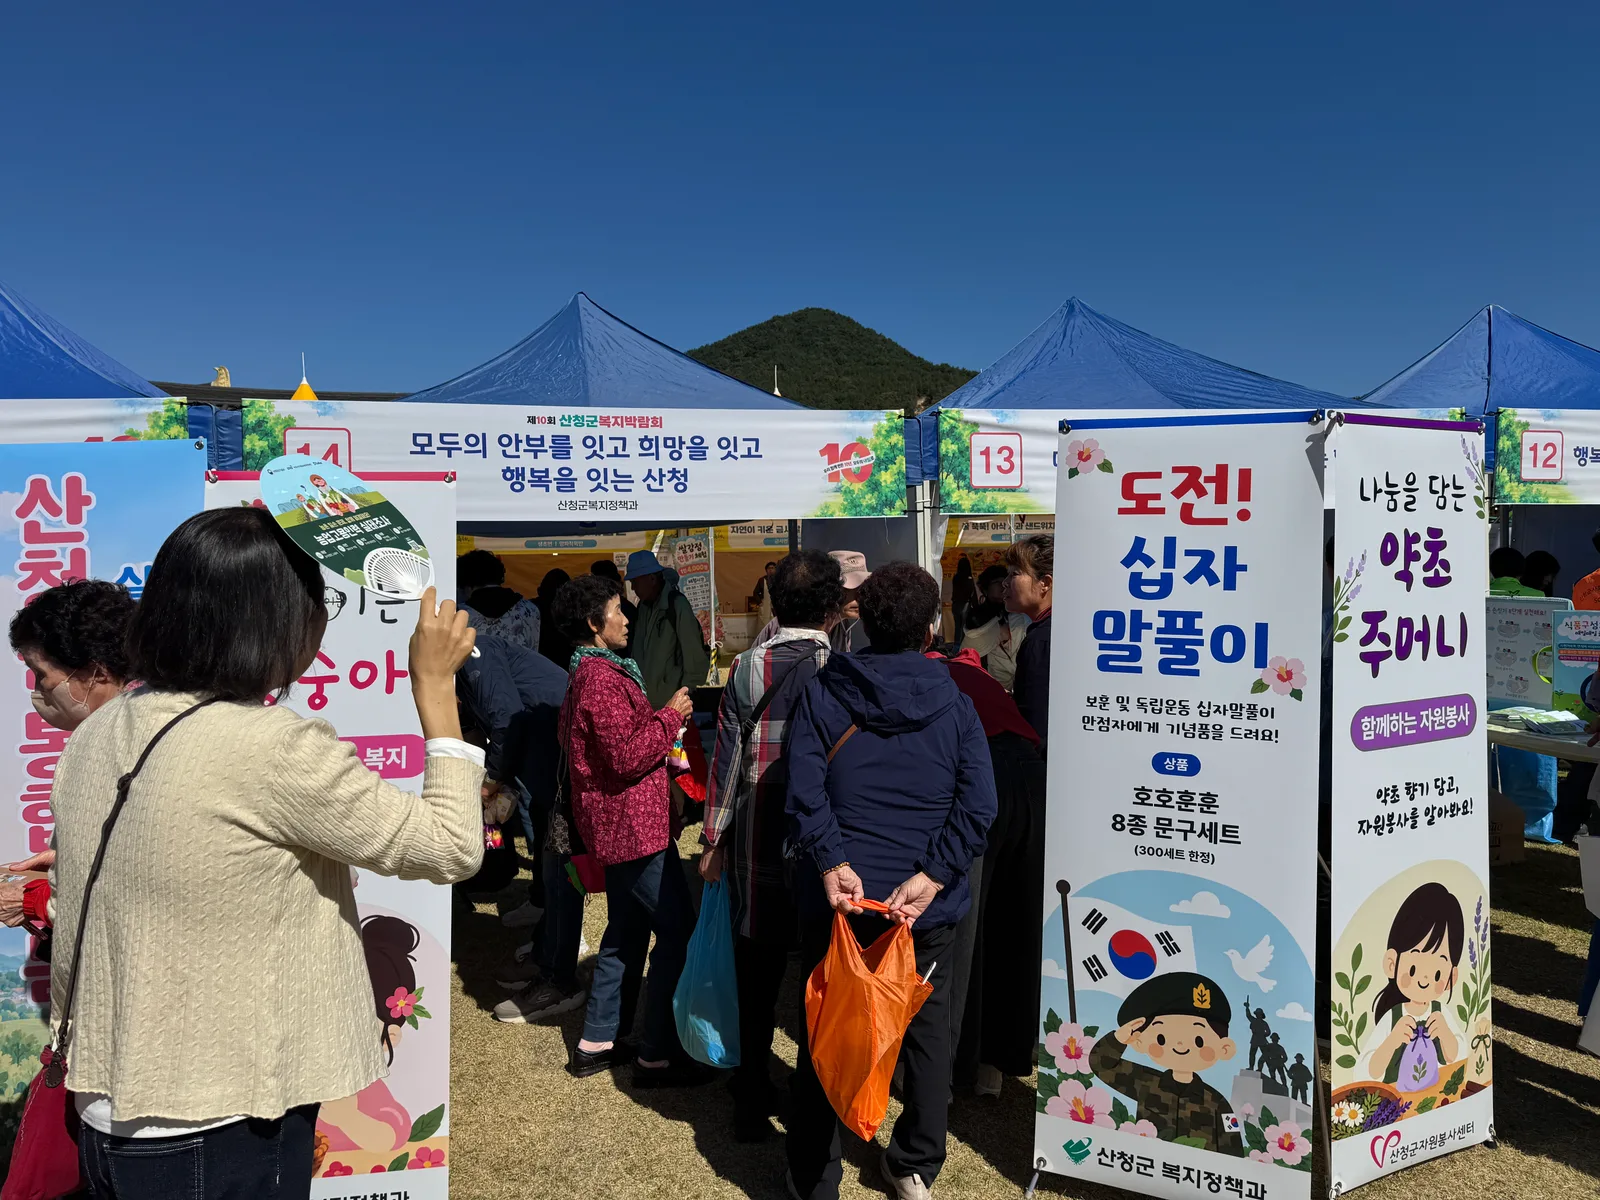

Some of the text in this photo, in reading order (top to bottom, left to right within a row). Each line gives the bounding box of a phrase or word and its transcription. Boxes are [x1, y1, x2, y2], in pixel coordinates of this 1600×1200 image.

[526, 414, 663, 428] 제10회 산청군복지박람회
[409, 432, 764, 461] 모두의 안부를 잇고 희망을 잇고
[979, 446, 1015, 475] 13
[1529, 442, 1557, 468] 12
[501, 466, 690, 494] 행복을 잇는 산청
[1360, 471, 1467, 513] 나눔을 담는
[557, 500, 639, 512] 산청군복지정책과
[1118, 464, 1252, 526] 도전!
[731, 525, 755, 533] 자연이
[1025, 522, 1055, 530] 샌드위치
[677, 555, 694, 563] 만들기
[695, 551, 708, 559] 체험
[679, 542, 702, 554] 쌀강정
[1379, 526, 1452, 592] 약초
[1120, 536, 1248, 601] 십자
[1565, 621, 1600, 631] 식품구성
[1093, 609, 1269, 677] 말풀이
[1359, 610, 1468, 679] 주머니
[264, 650, 408, 711] 숭아
[1086, 695, 1275, 720] 보훈 및 독립운동 십자말풀이
[1361, 703, 1470, 740] 함께하는 자원봉사
[1082, 715, 1279, 744] 만점자에게 기념품을 드려요!
[363, 745, 407, 771] 복지
[1164, 758, 1189, 772] 상품
[1132, 786, 1219, 815] 호호훈훈
[1376, 785, 1400, 805] 약초
[1404, 781, 1429, 801] 향기
[1111, 813, 1242, 845] 8종 문구세트
[1357, 797, 1473, 836] 자원봉사를 알아봐요!
[1134, 844, 1216, 866] (300세트 한정)
[1389, 1121, 1475, 1165] 산청군자원봉사센터
[1097, 1145, 1268, 1200] 산청군 복지정책과
